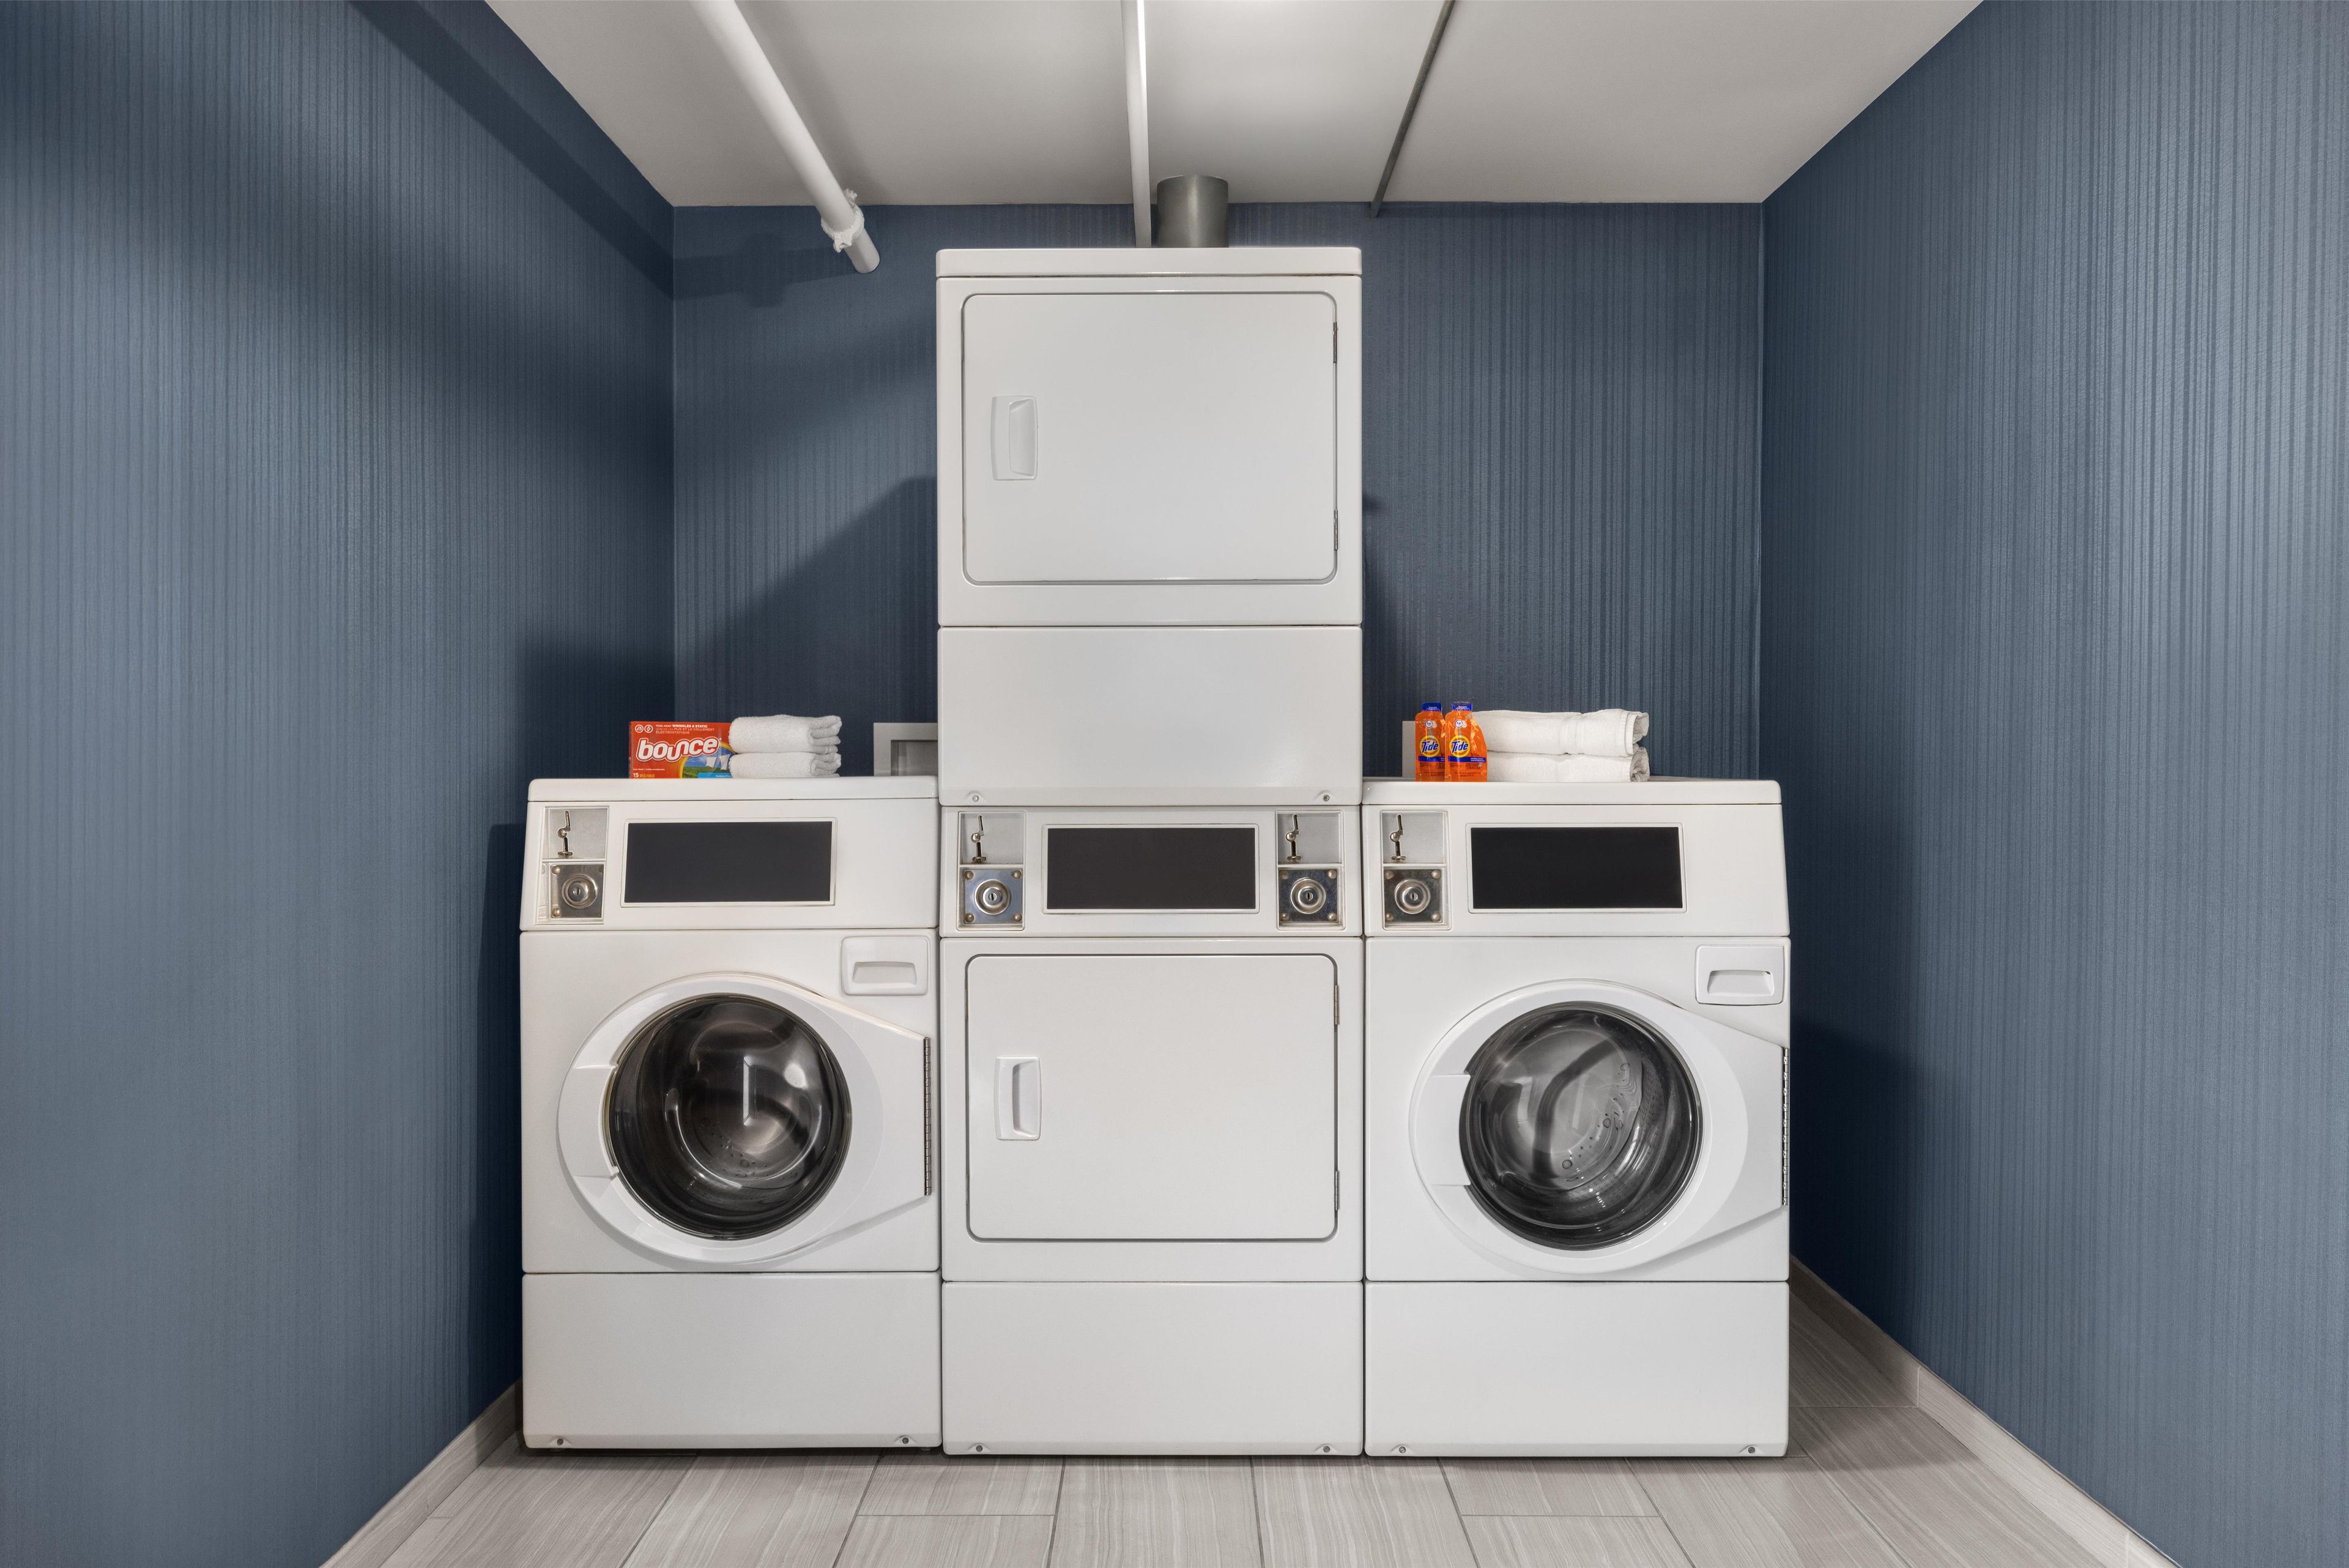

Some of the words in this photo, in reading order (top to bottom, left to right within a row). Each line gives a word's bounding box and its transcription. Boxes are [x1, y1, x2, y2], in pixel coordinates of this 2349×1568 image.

[637, 737, 719, 762] bounce
[1422, 740, 1439, 753] Tide
[1452, 740, 1469, 754] Tide
